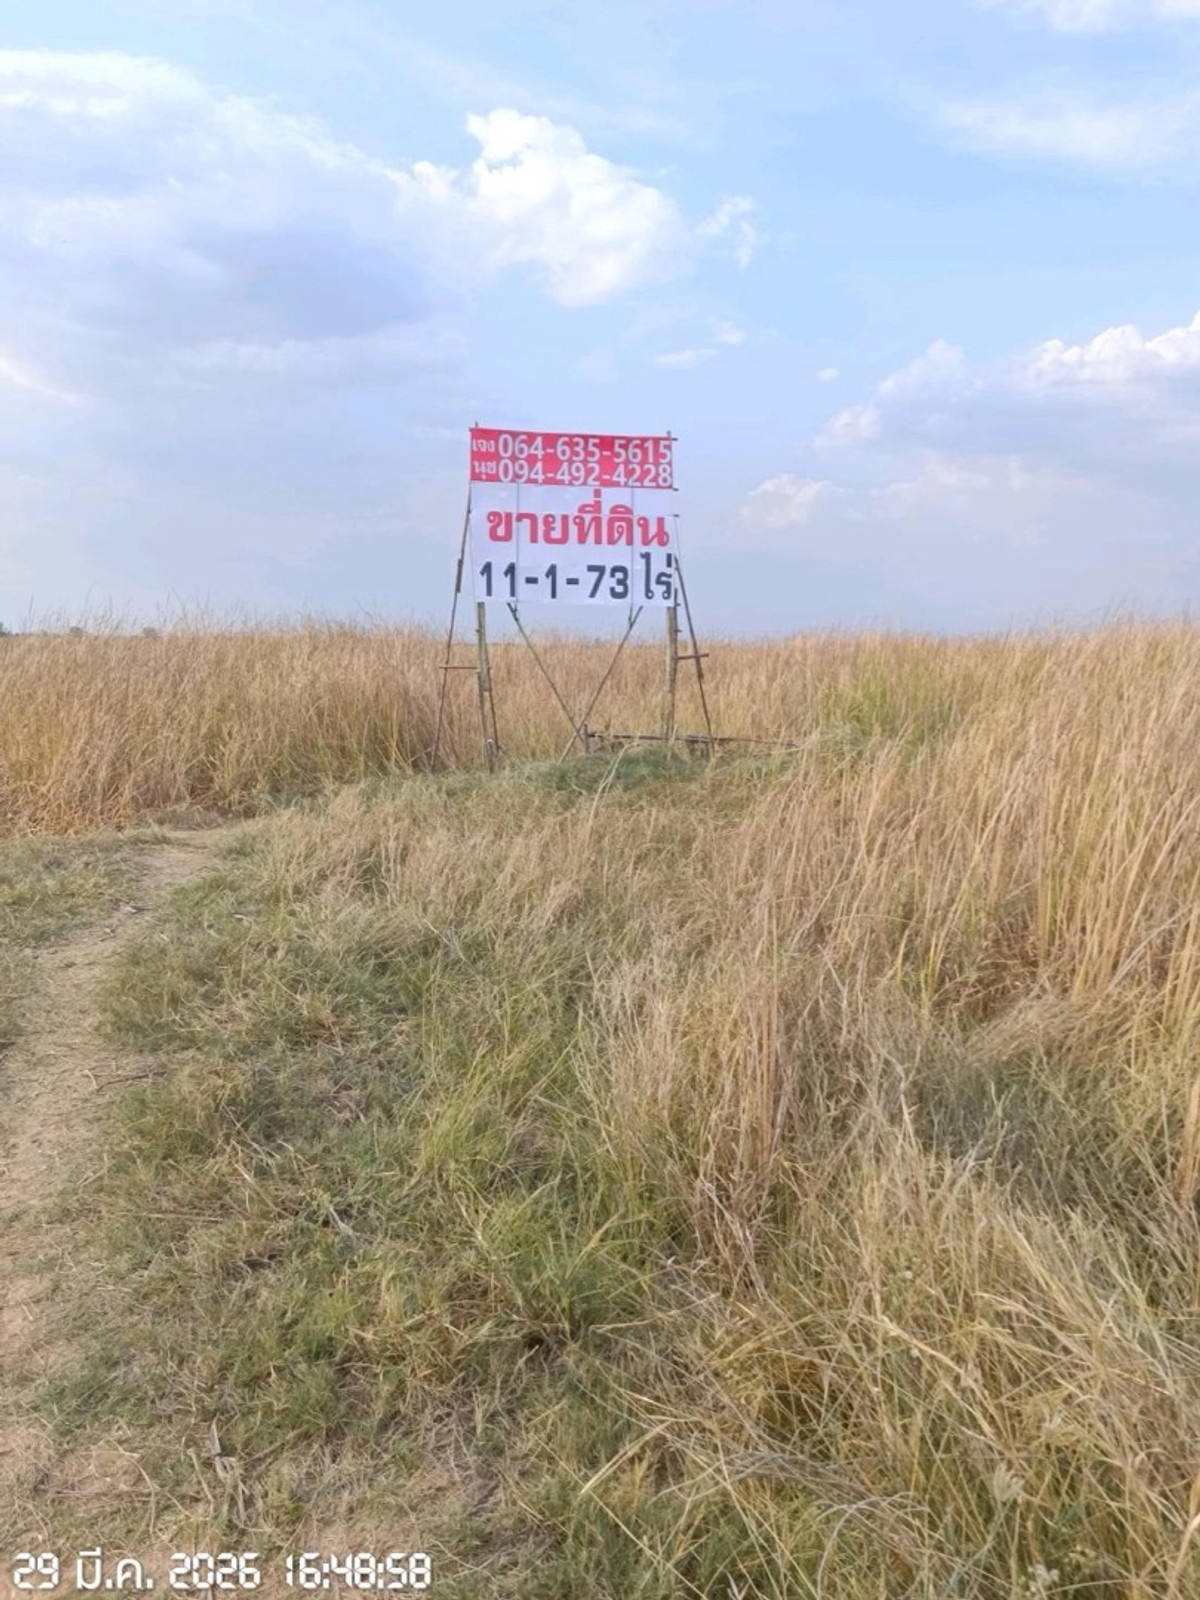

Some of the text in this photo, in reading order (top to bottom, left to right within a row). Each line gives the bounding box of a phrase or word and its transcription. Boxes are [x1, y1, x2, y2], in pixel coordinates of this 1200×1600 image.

[498, 433, 671, 464] 064-635-5615
[498, 459, 672, 487] 094-492-4228
[486, 488, 670, 547] ขายที่ดิน
[479, 552, 673, 600] 11-1-73 ไร่
